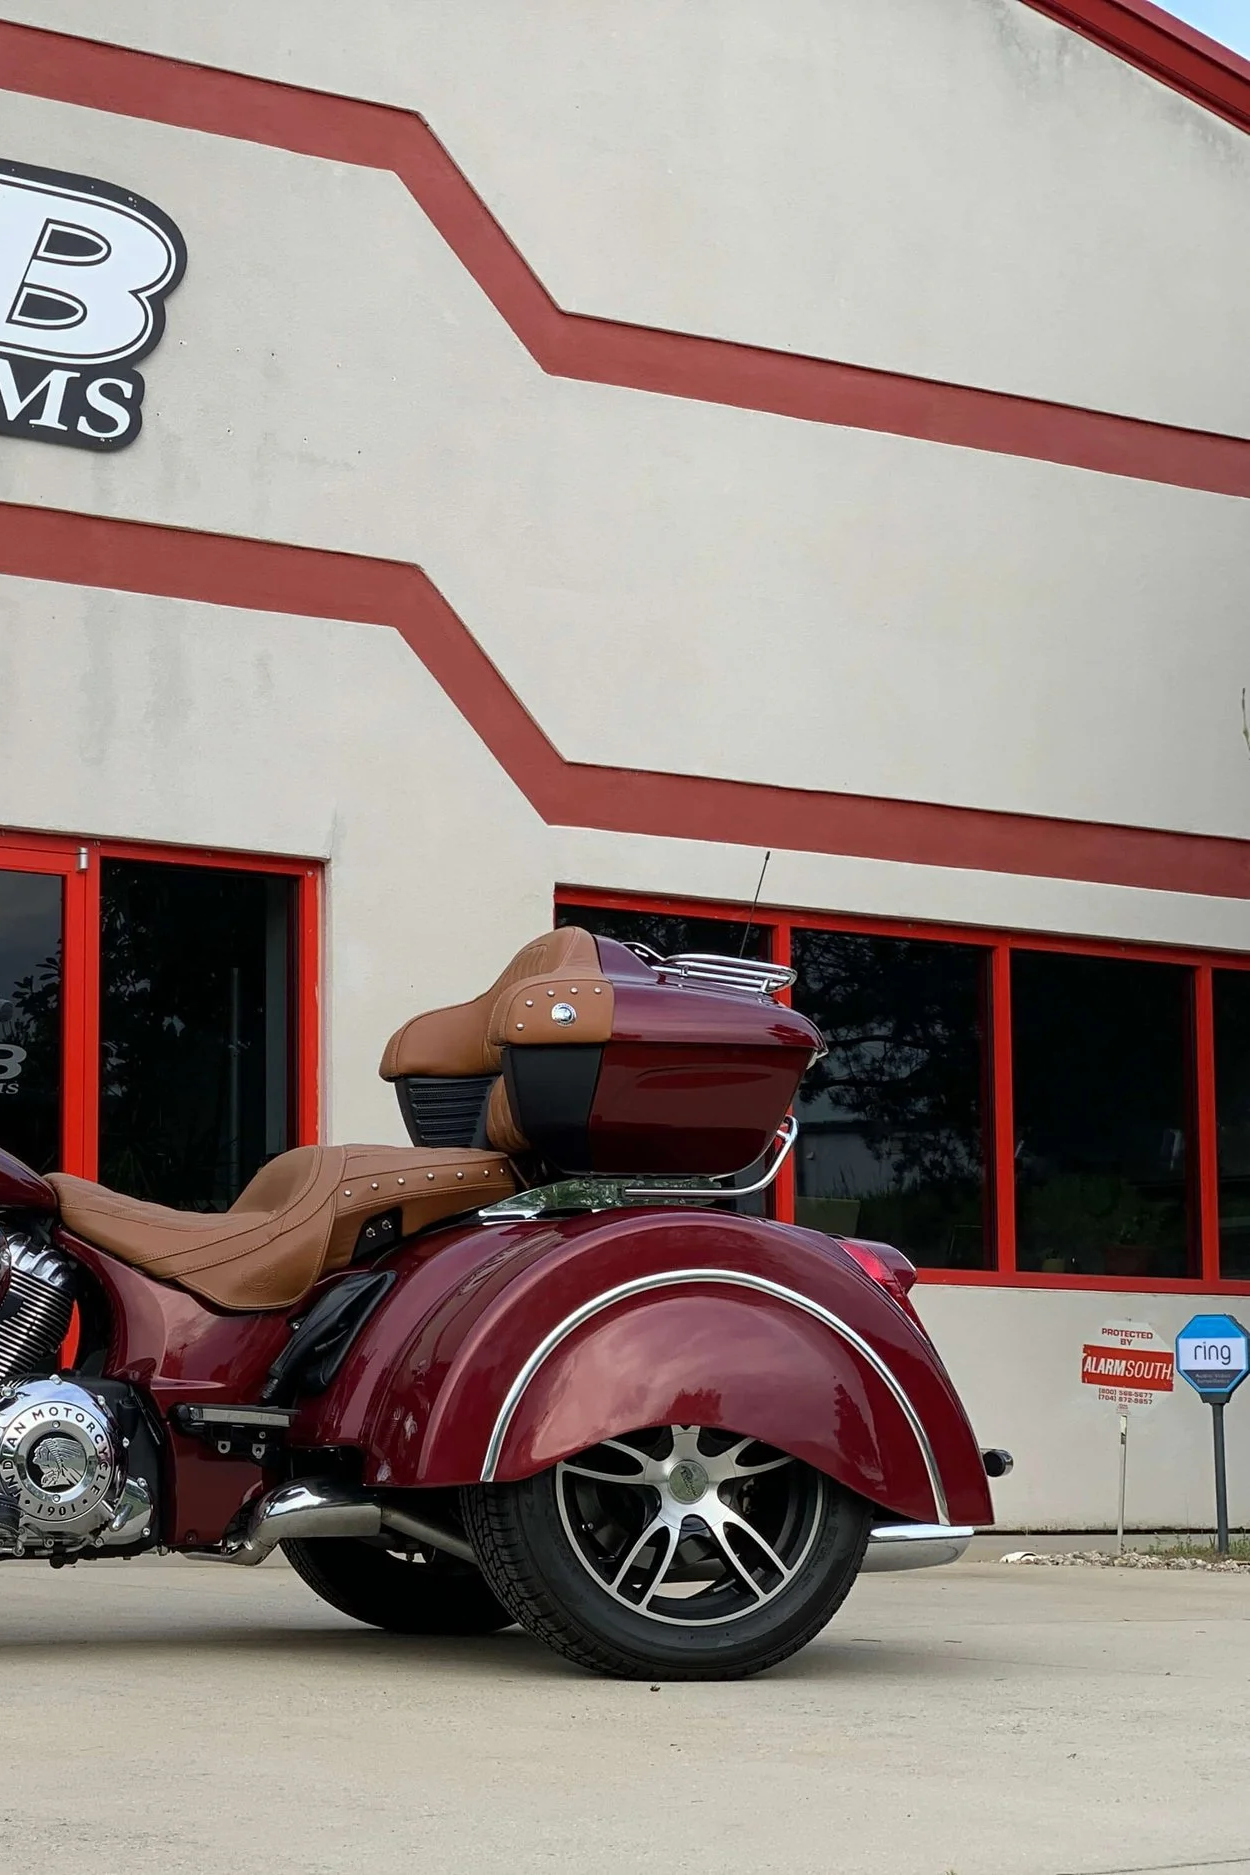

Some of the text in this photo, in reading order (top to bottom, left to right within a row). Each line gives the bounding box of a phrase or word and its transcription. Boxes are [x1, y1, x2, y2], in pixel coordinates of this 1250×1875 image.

[1101, 1327, 1154, 1340] PROTECTED
[1120, 1338, 1133, 1346] BY
[1194, 1341, 1231, 1366] ring
[2, 1406, 109, 1498] INDIAN MOTORCYCLE
[37, 1503, 76, 1516] 1901
